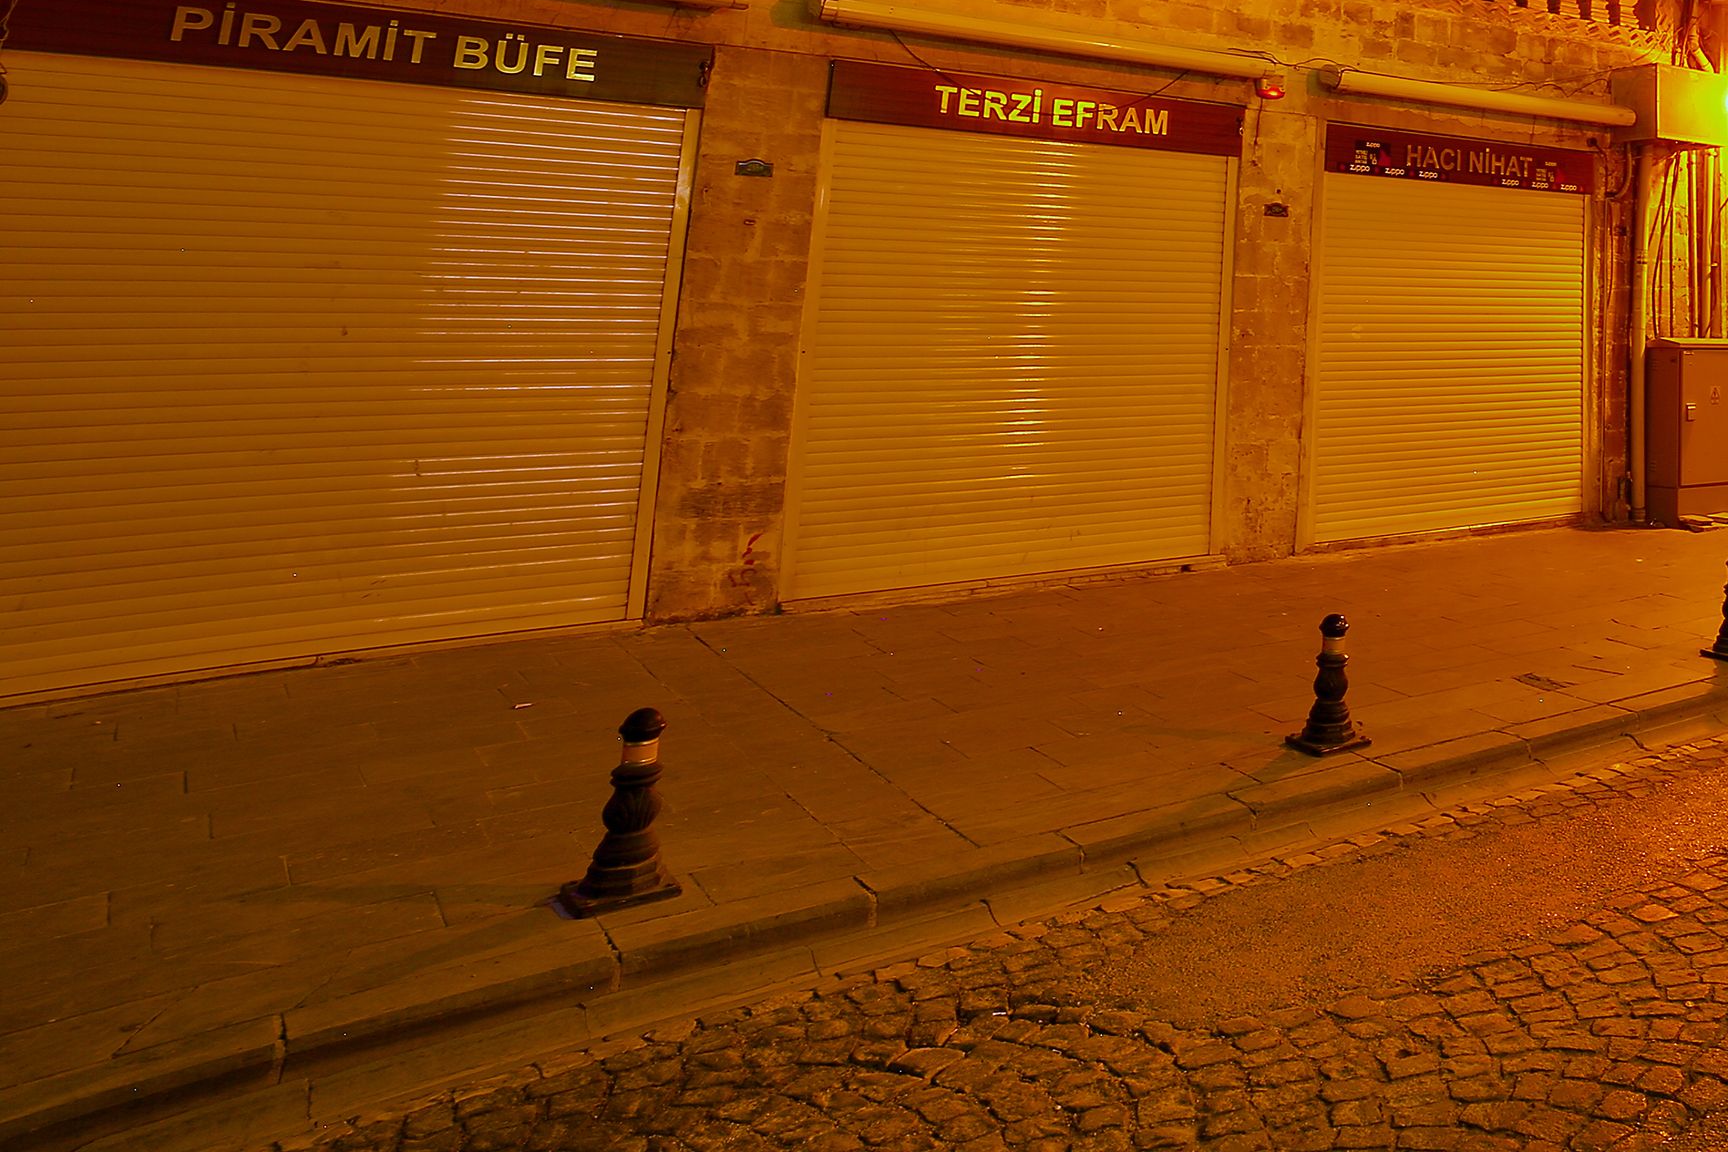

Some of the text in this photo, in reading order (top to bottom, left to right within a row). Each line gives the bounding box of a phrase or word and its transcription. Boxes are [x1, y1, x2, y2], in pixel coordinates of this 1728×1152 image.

[169, 1, 599, 83] PİRAMİT BÜFE
[935, 85, 1169, 136] TERZİ EFRAM
[1407, 144, 1461, 171] HACI
[1469, 148, 1533, 178] NİHAT
